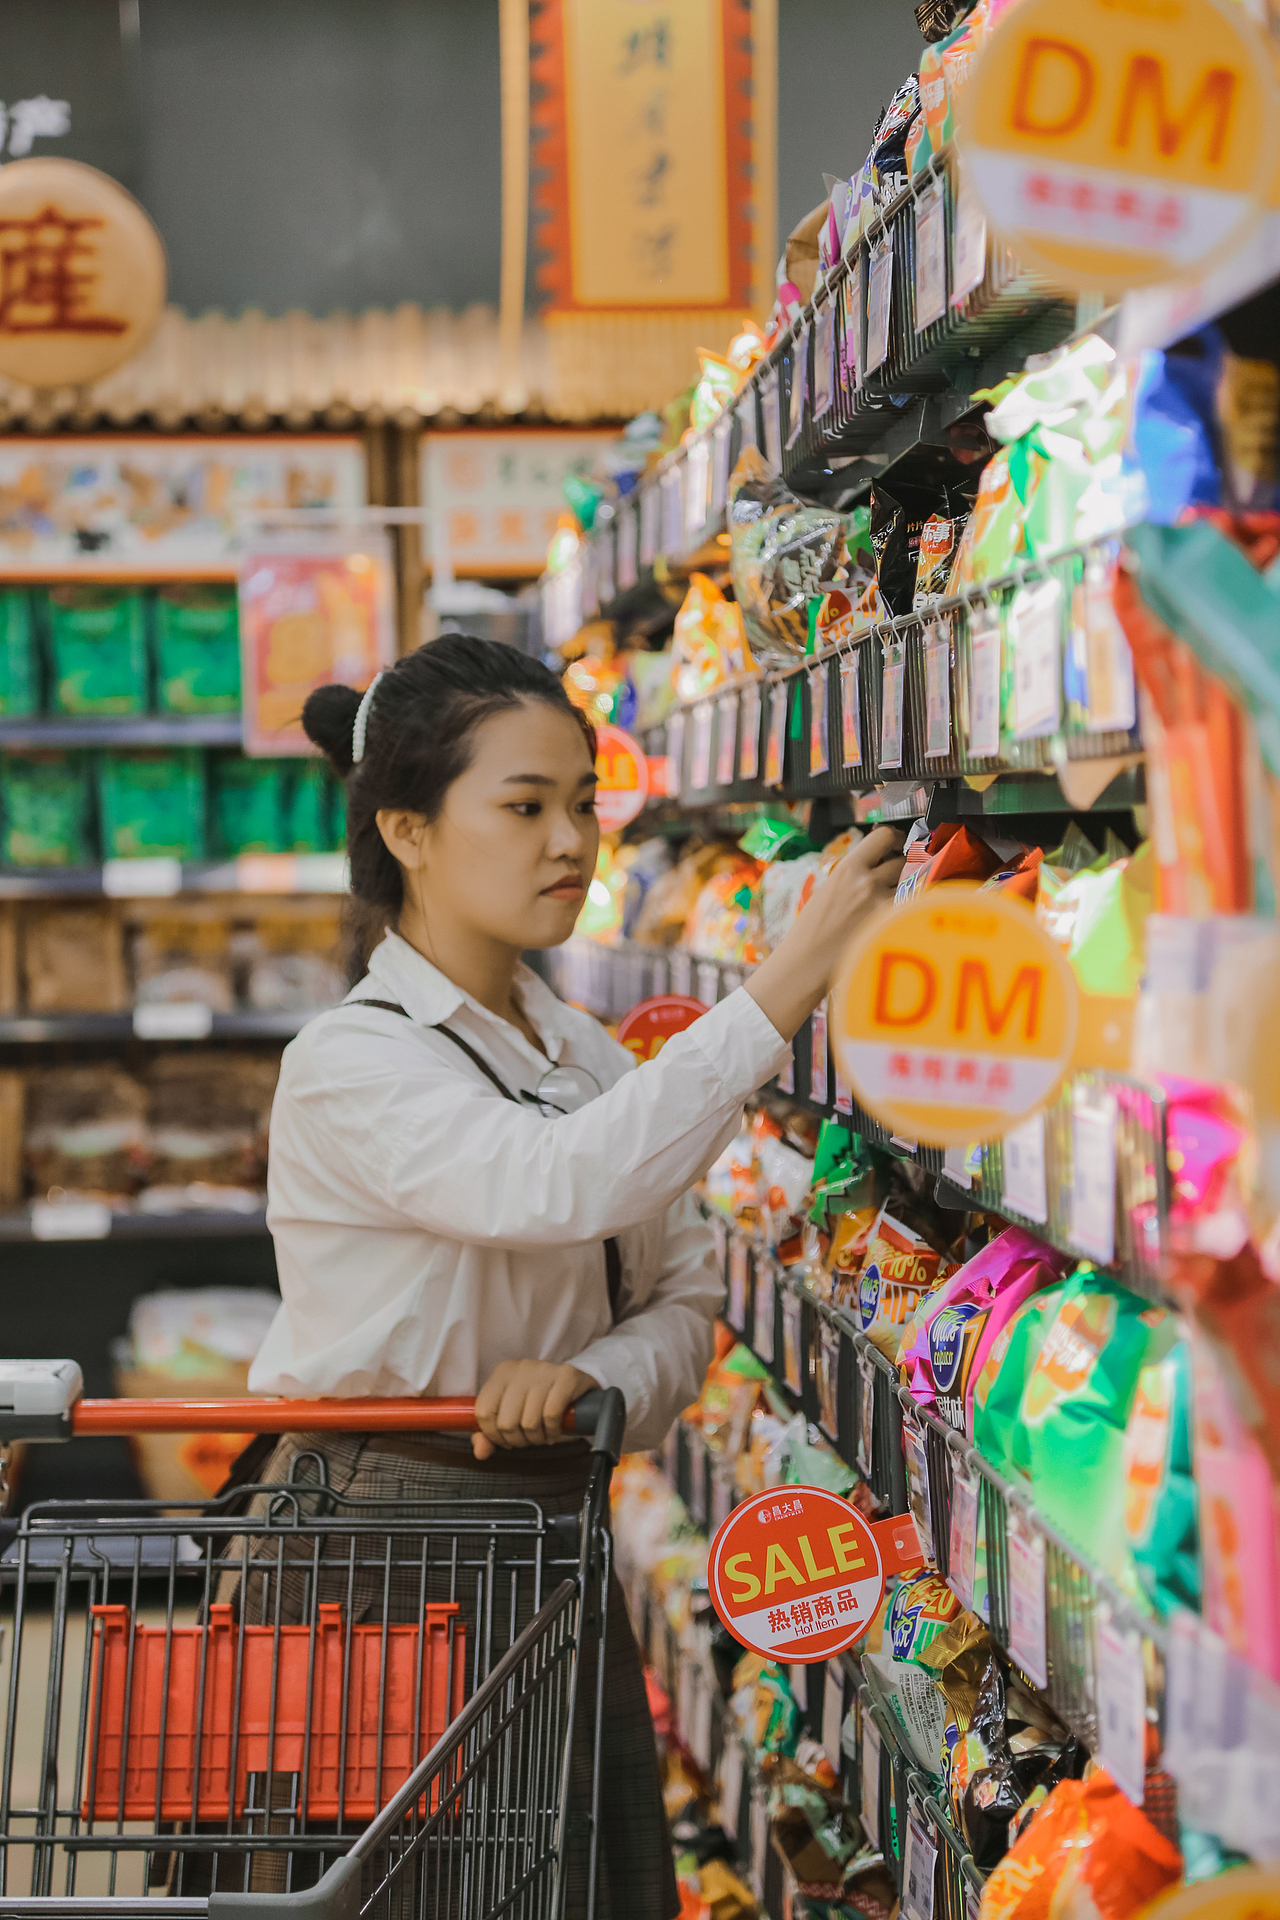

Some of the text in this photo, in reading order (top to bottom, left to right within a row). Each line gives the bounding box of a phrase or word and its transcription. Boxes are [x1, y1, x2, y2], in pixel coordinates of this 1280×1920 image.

[1011, 36, 1236, 165] DM
[873, 951, 1043, 1040] DM
[724, 1522, 866, 1603] SALE
[767, 1589, 859, 1633] 热销商品
[794, 1617, 839, 1637] Hot Item
